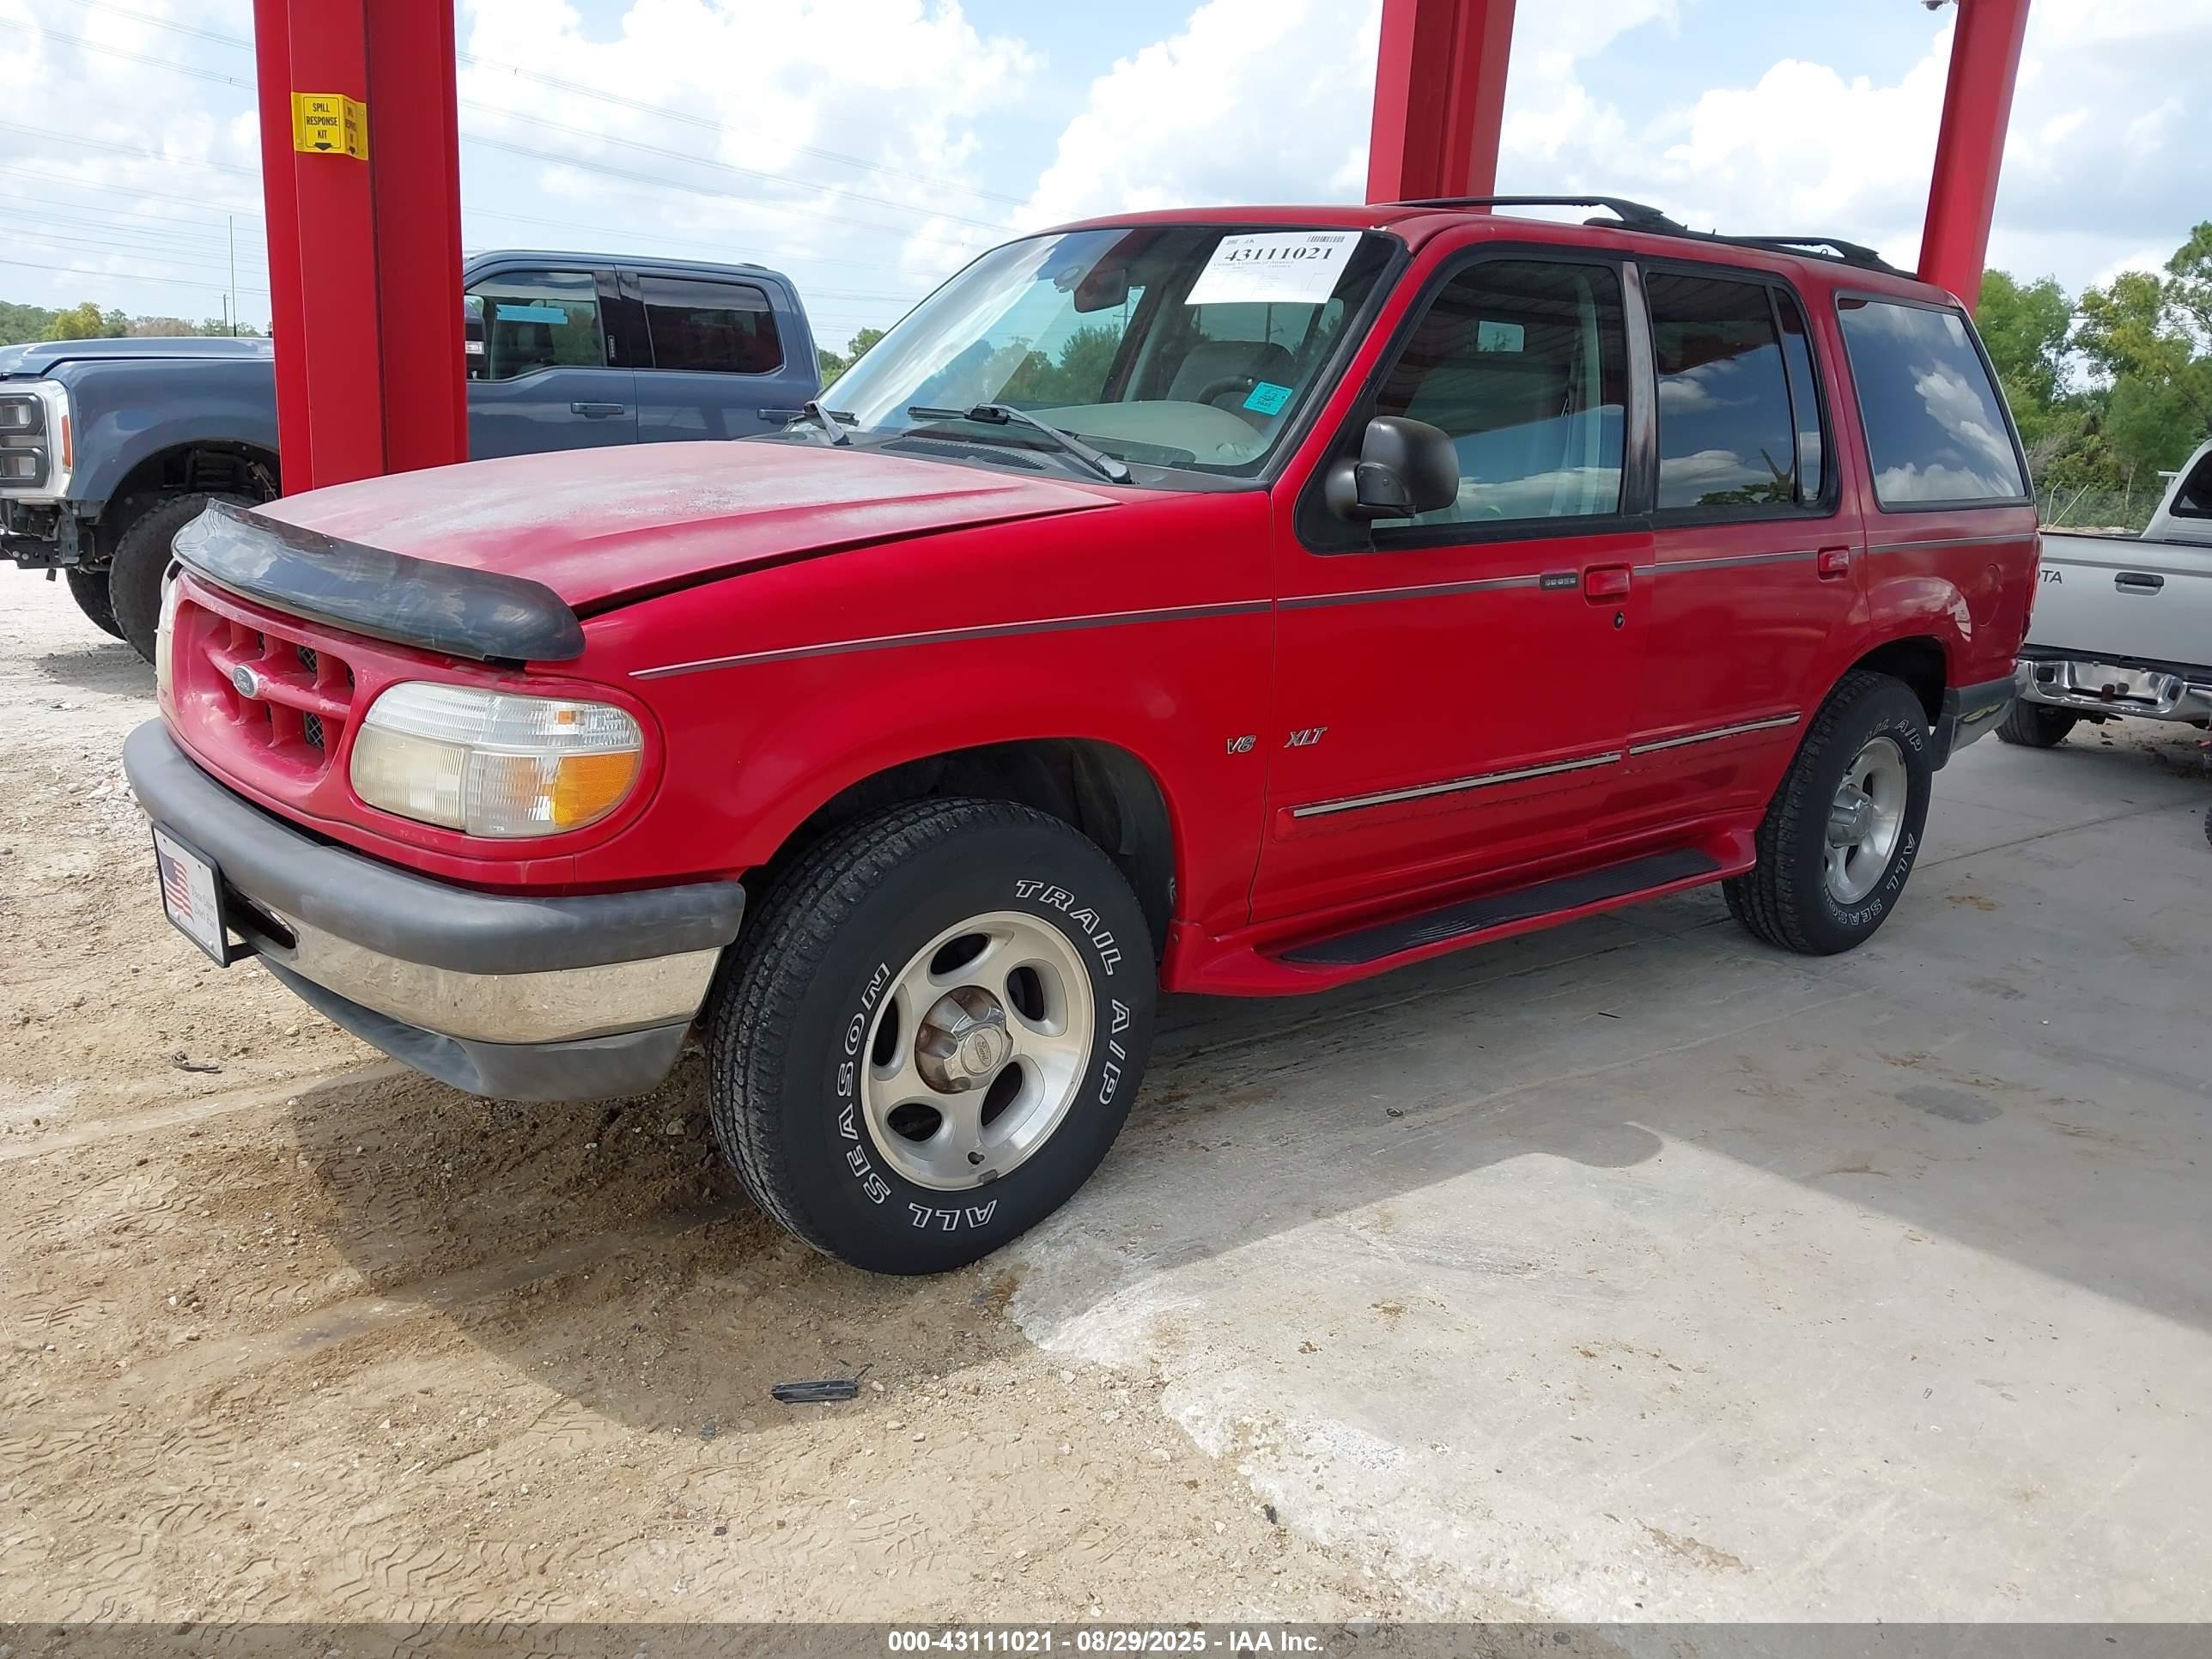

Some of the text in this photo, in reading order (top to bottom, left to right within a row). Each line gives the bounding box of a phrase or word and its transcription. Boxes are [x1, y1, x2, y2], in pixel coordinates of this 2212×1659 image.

[313, 102, 330, 112] SPILL
[306, 115, 338, 127] RESPONSE
[317, 129, 327, 139] KIT
[1224, 246, 1334, 262] 43111021
[1227, 734, 1256, 755] V8
[1283, 727, 1328, 749] XLT
[1894, 719, 1923, 751] A/P
[1886, 832, 1916, 890] ALL
[1016, 879, 1130, 1105] TRAIL A/P
[837, 962, 998, 1231] ALL SEASON
